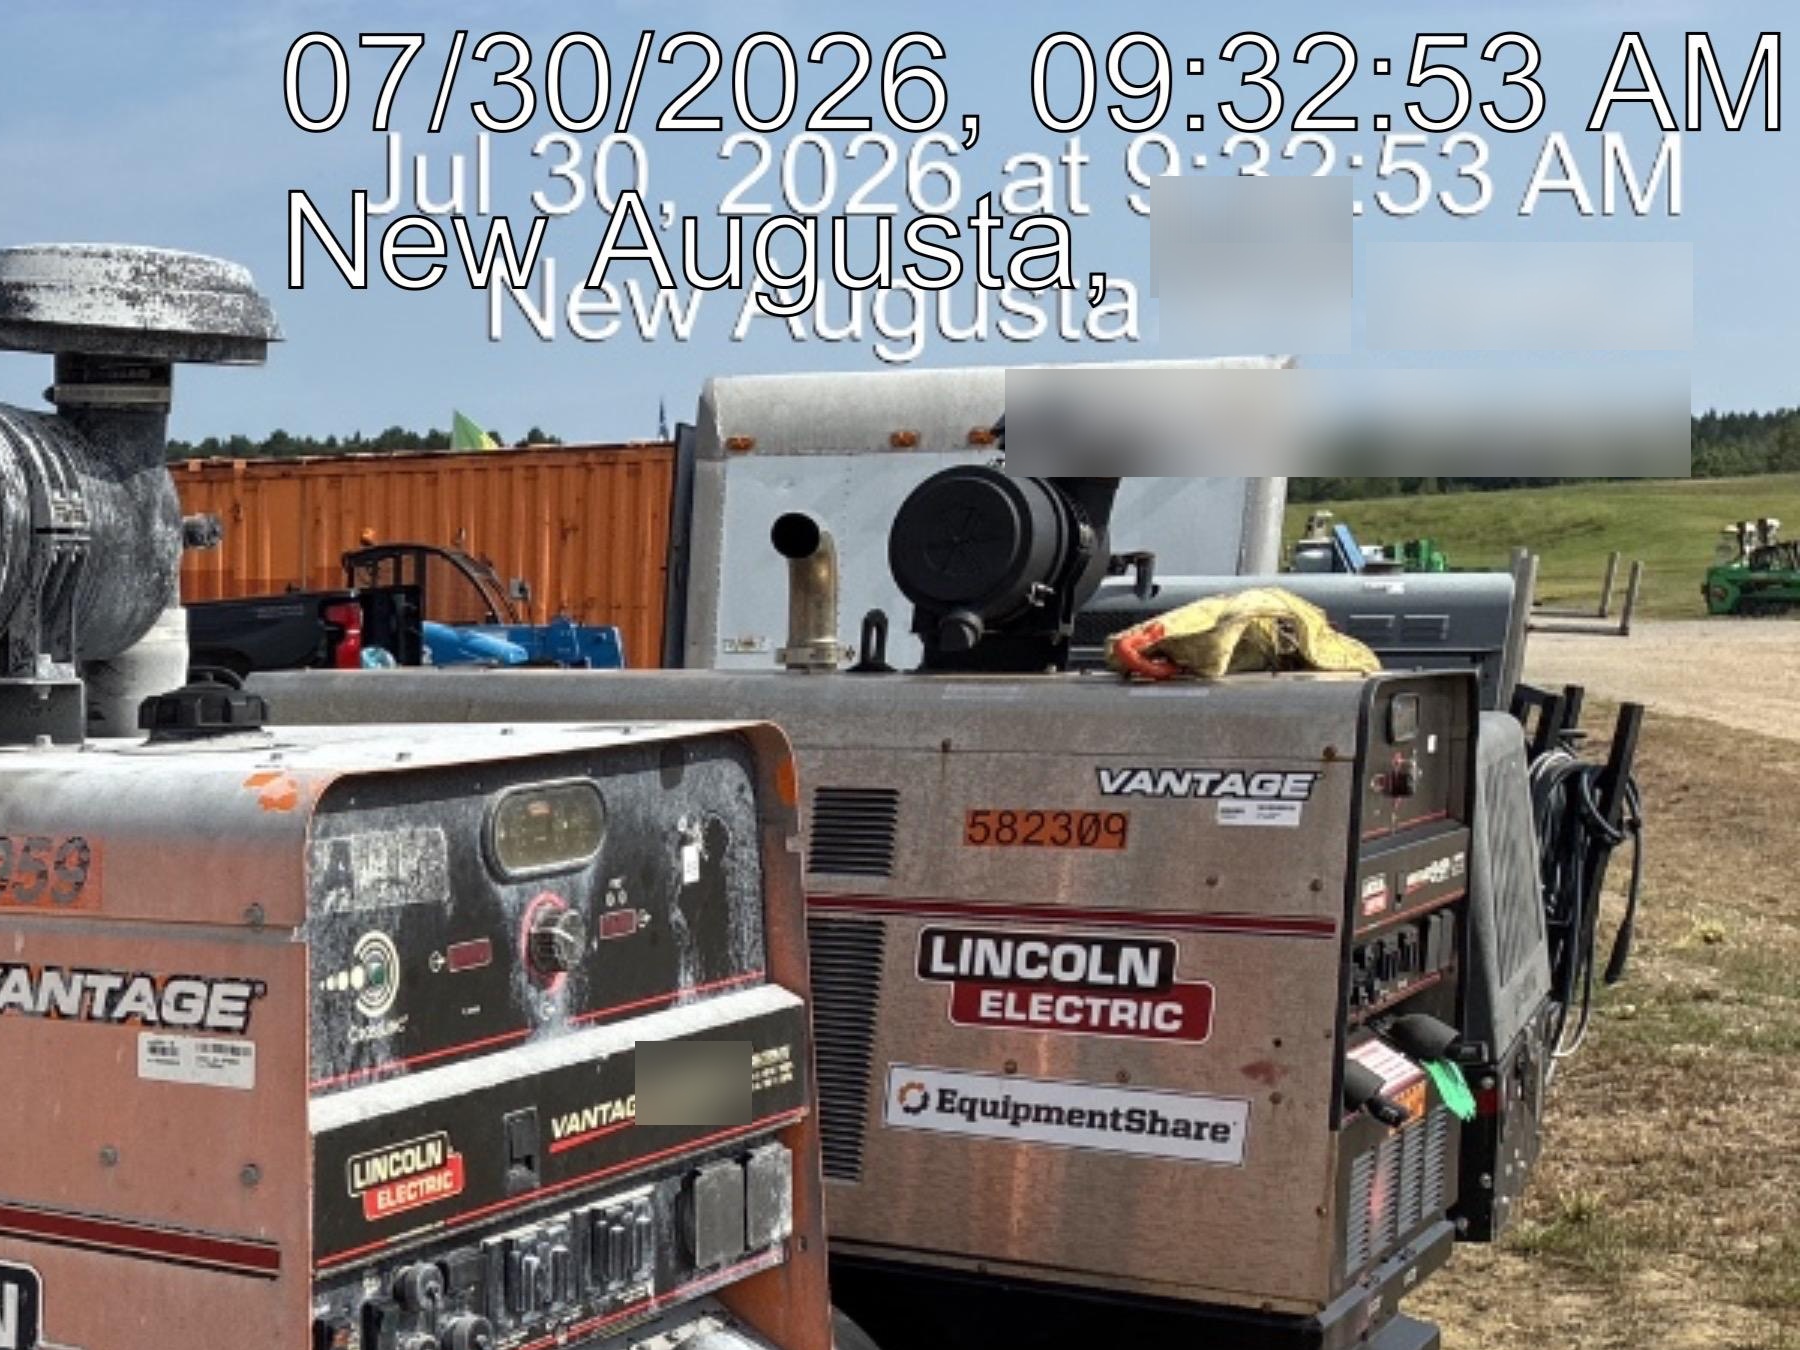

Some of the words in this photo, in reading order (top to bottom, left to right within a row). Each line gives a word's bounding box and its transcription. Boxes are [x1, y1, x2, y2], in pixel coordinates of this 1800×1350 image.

[1099, 768, 1316, 800] VANTAGE
[967, 810, 1127, 848] 582309
[930, 934, 1160, 989] LINCOLN
[978, 992, 1184, 1034] ELECTRIC
[550, 1093, 636, 1140] VANTAG
[936, 1087, 1232, 1145] EquipmentShare
[352, 1138, 442, 1190] LINCOLN
[376, 1169, 454, 1210] ELECTRIC
